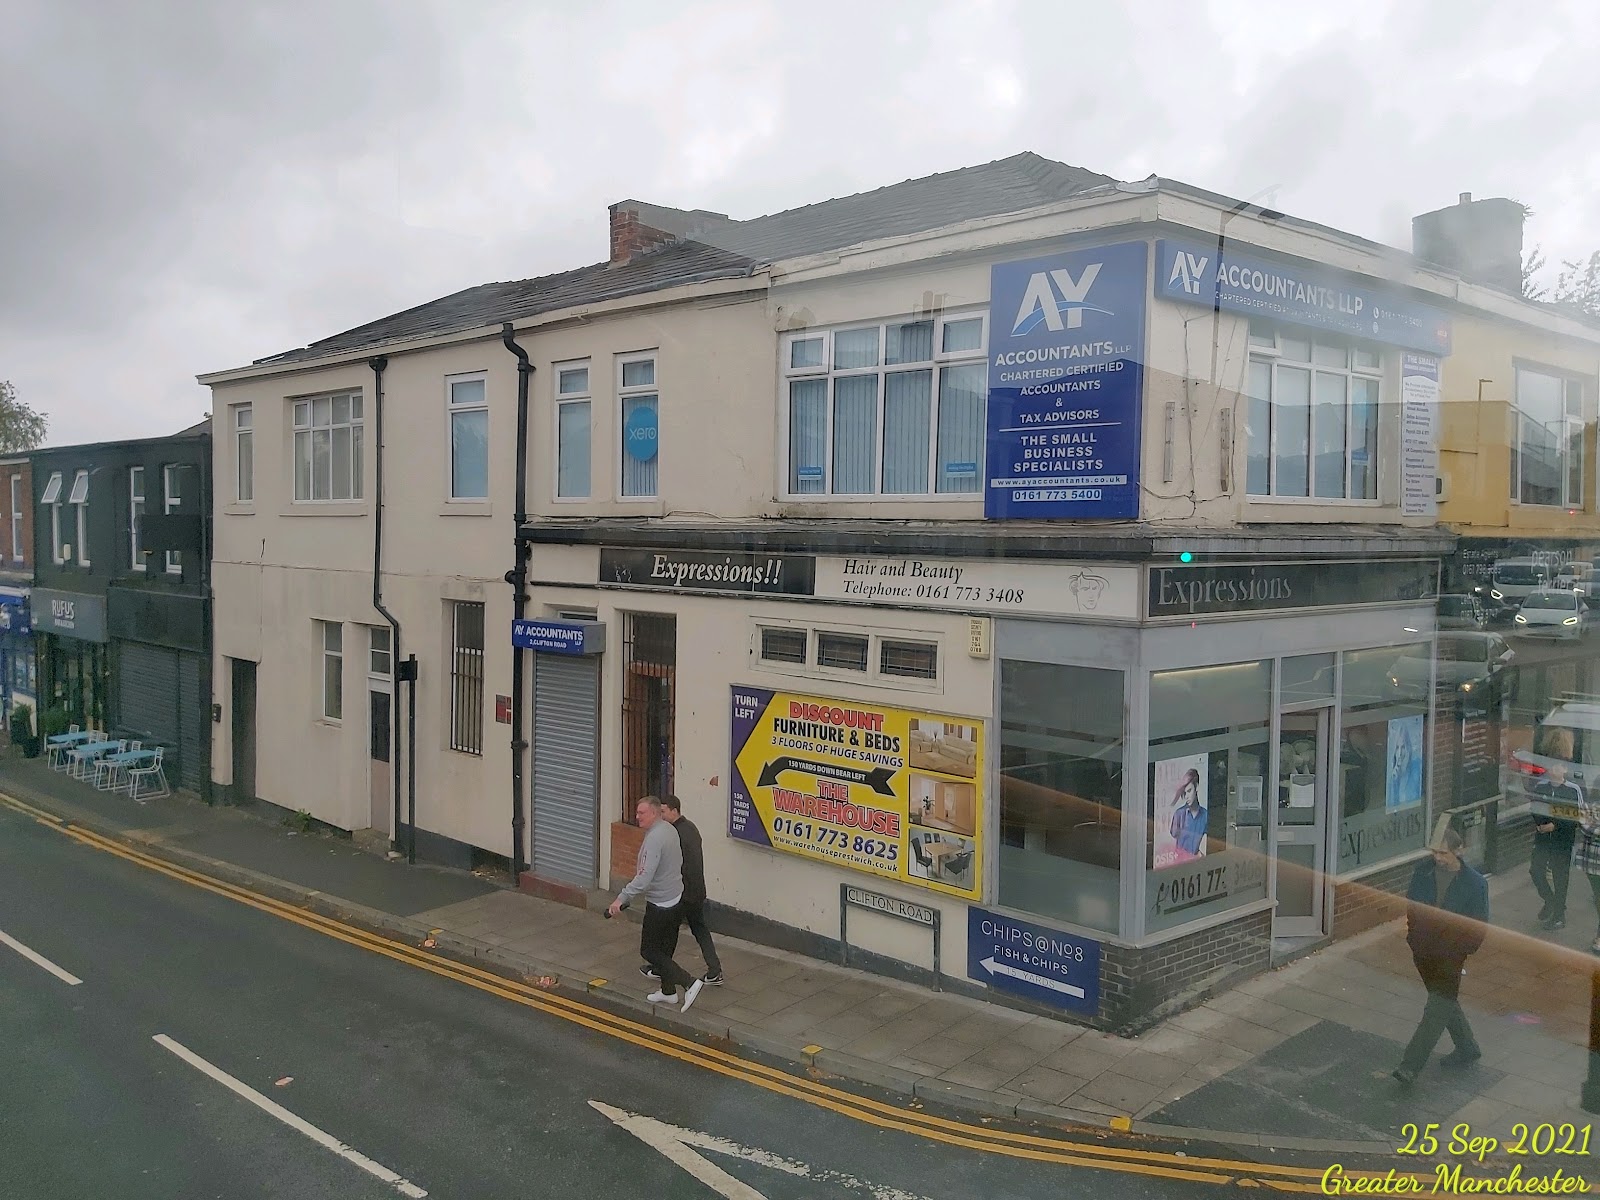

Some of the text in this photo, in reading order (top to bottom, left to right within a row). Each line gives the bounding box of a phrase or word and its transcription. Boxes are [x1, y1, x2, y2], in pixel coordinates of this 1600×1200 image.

[1168, 251, 1208, 294] AY
[1216, 262, 1363, 315] ACCOUNTANTS LLP
[1010, 263, 1104, 336] AY
[1252, 299, 1281, 312] CERTFED
[995, 341, 1132, 366] ACCOUNTANTS LLP
[1000, 361, 1124, 382] CHARTERED CERTIFIED
[1020, 380, 1101, 396] ACCOUNTANTS
[1055, 398, 1063, 407] &
[1020, 409, 1100, 424] TAX ADVISORS
[629, 427, 657, 440] xero
[1021, 433, 1097, 446] THE SMALL
[1024, 446, 1093, 459] BUSINESS
[1014, 459, 1104, 473] SPECIALISTS
[997, 476, 1121, 486] www.ayaccountants.co.uk
[1014, 490, 1101, 500] 0161 773 5400
[650, 554, 783, 586] Expressions!!
[843, 559, 964, 584] Hair and Beauty
[843, 580, 1024, 604] Telephone: 0161 773 3408
[1158, 568, 1292, 613] Expressions
[52, 600, 75, 619] RUFUS
[515, 625, 583, 641] AY ACCOUNTANTS
[554, 641, 567, 649] ROAD
[734, 694, 758, 707] TURN
[734, 707, 755, 720] LEFT
[789, 700, 884, 732] DISCOUNT
[773, 717, 901, 753] FURNITURE & BEDS
[771, 736, 904, 768] 3 FLOORS OF HUGE SAVINGS
[788, 760, 866, 781] 150 YARDS DOWN BEAR LEFT
[817, 779, 849, 801] THE
[733, 800, 750, 809] YARDS
[733, 808, 750, 817] DOWN
[772, 787, 901, 838] WAREHOUSE
[732, 823, 745, 832] LEFT
[733, 816, 746, 824] BEAR
[773, 817, 899, 861] 0161 773 8625
[773, 836, 898, 873] www.warehouseprestwich.co.uk
[1172, 873, 1201, 903] 0161
[848, 888, 932, 923] CLIFTON ROAD
[994, 945, 1020, 961] FISH
[1031, 956, 1069, 975] CHIPS
[1006, 967, 1056, 989] 15 YARDS
